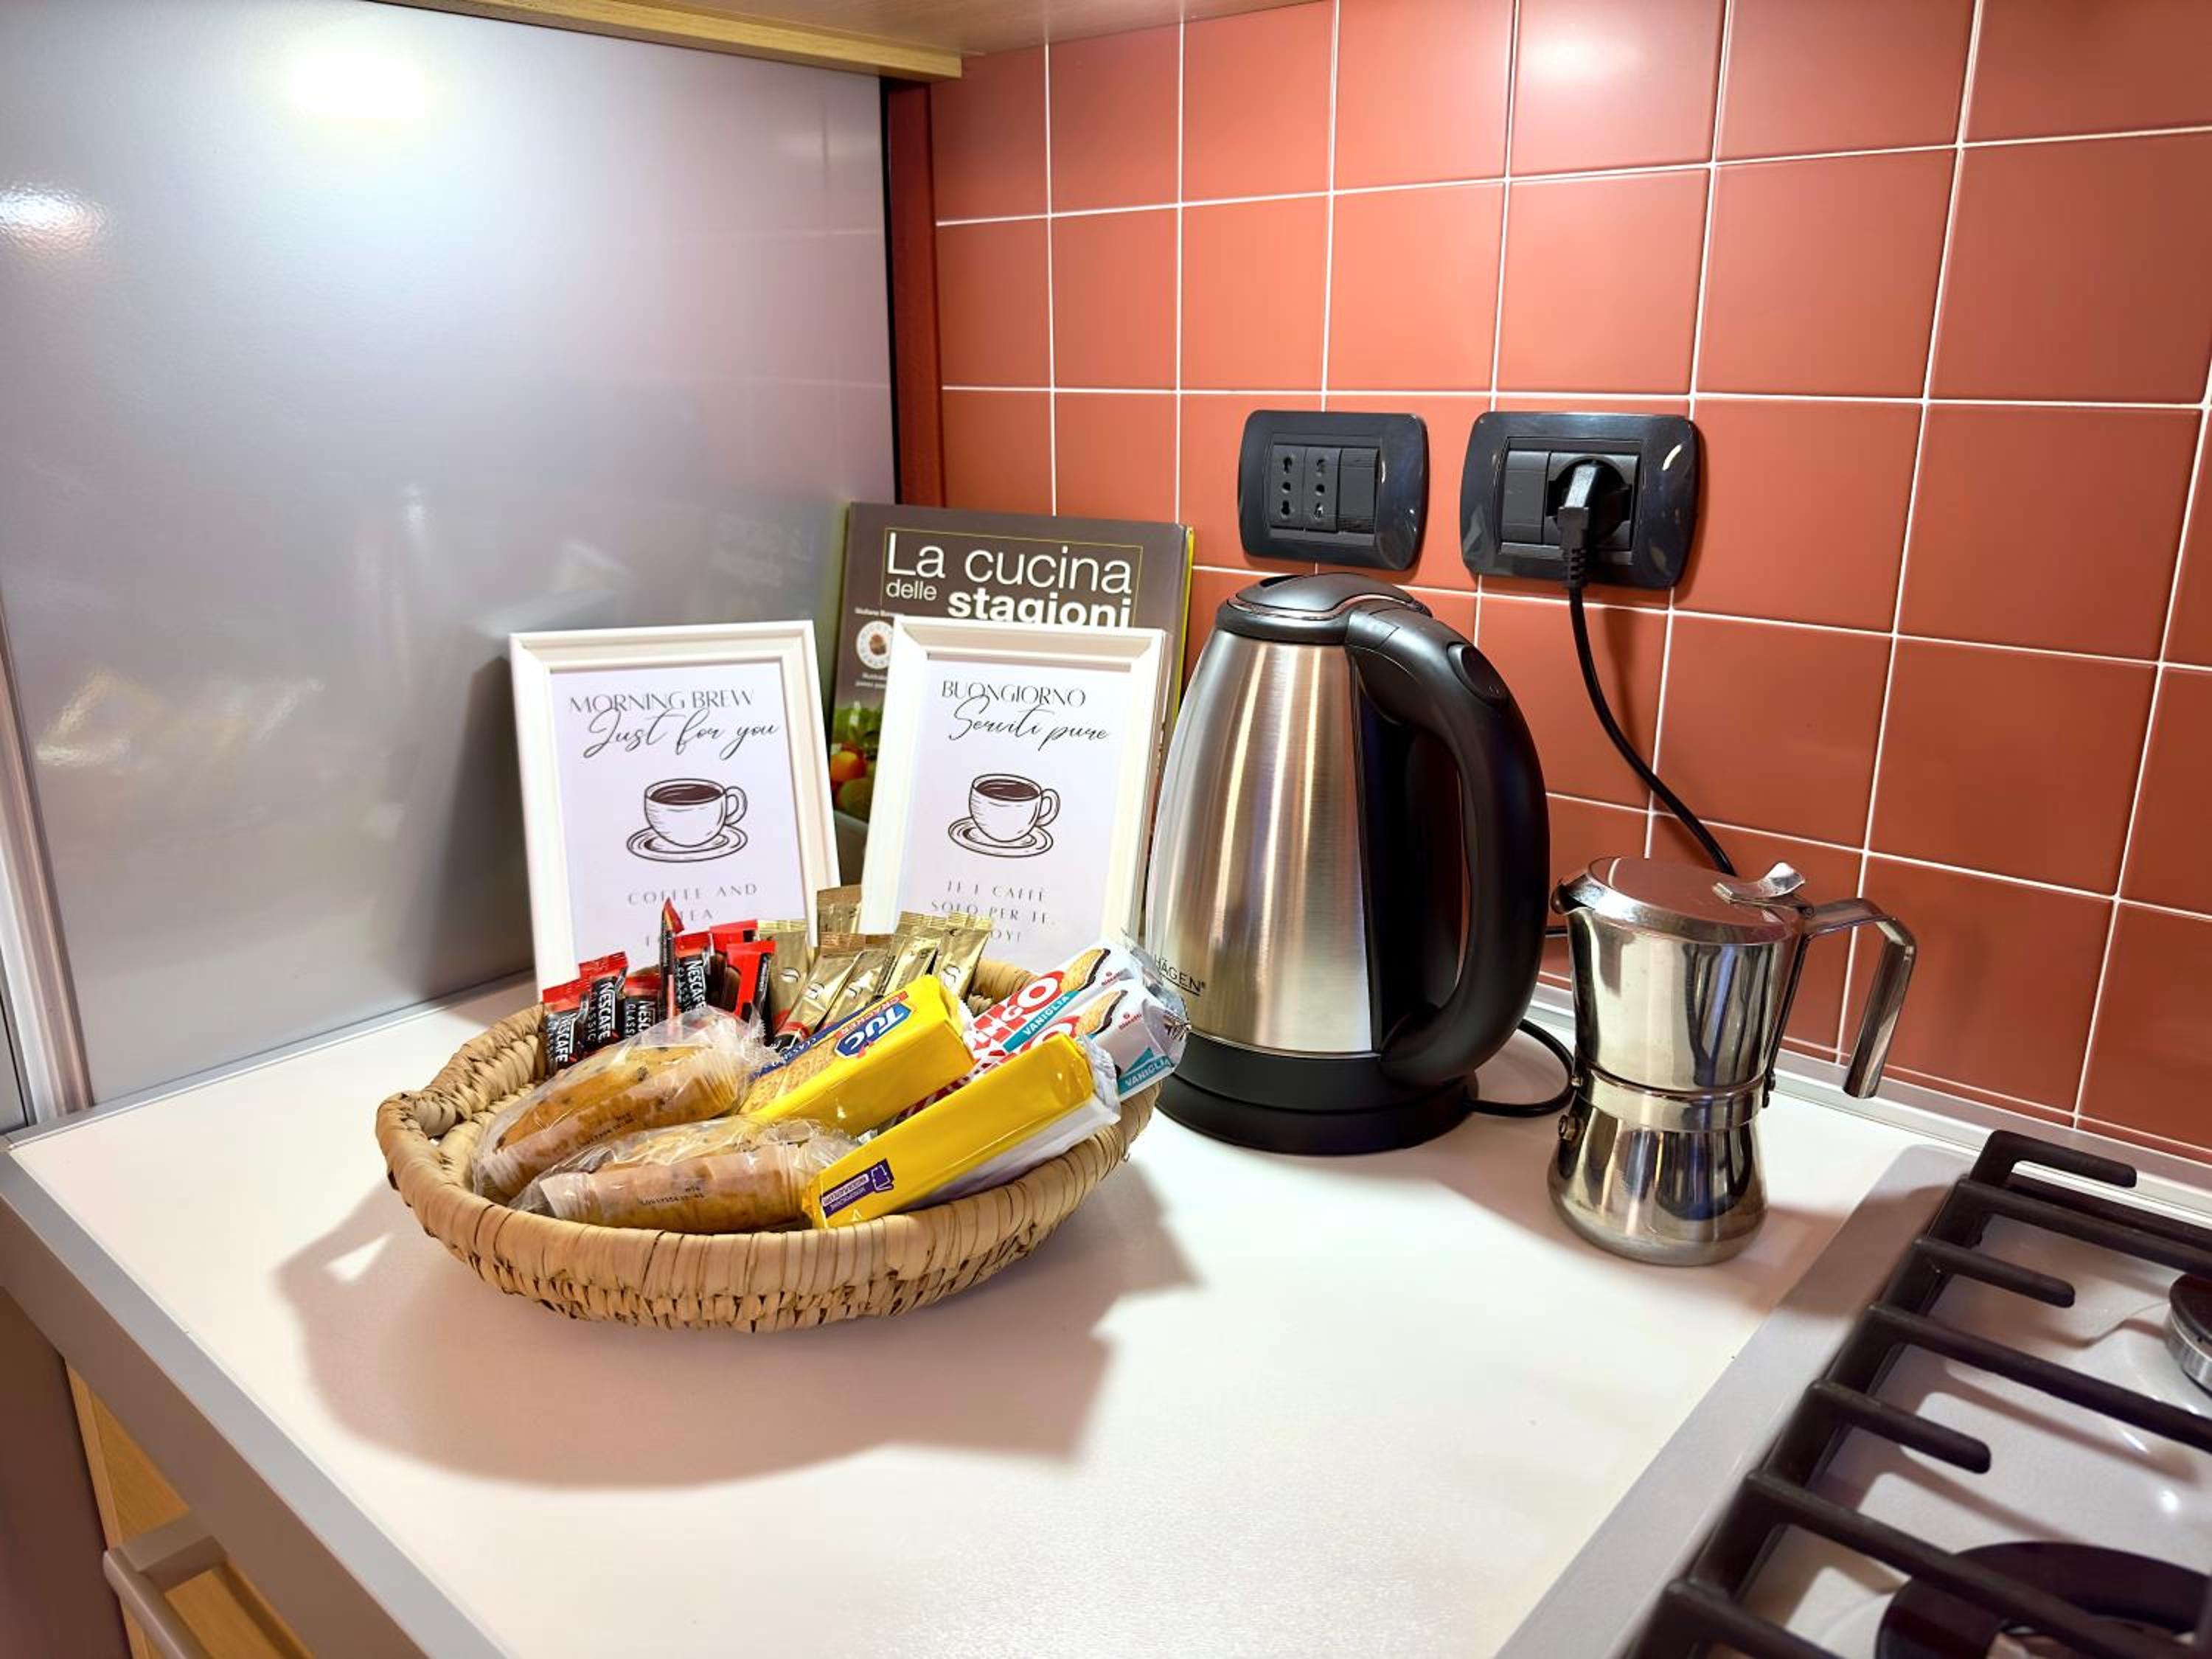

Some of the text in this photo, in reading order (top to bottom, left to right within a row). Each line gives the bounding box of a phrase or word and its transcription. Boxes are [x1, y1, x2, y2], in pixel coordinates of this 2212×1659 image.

[887, 532, 1133, 594] La cucina
[886, 579, 1132, 628] delle stagioni
[569, 689, 754, 713] MORNING BREW
[942, 680, 1087, 708] BUONGIORNO
[583, 707, 780, 760] Just for you
[1037, 725, 1109, 751] pure
[844, 1007, 904, 1050] TUC
[1023, 995, 1071, 1036] VANIGLIA
[1124, 1057, 1172, 1088] VANIGLIA
